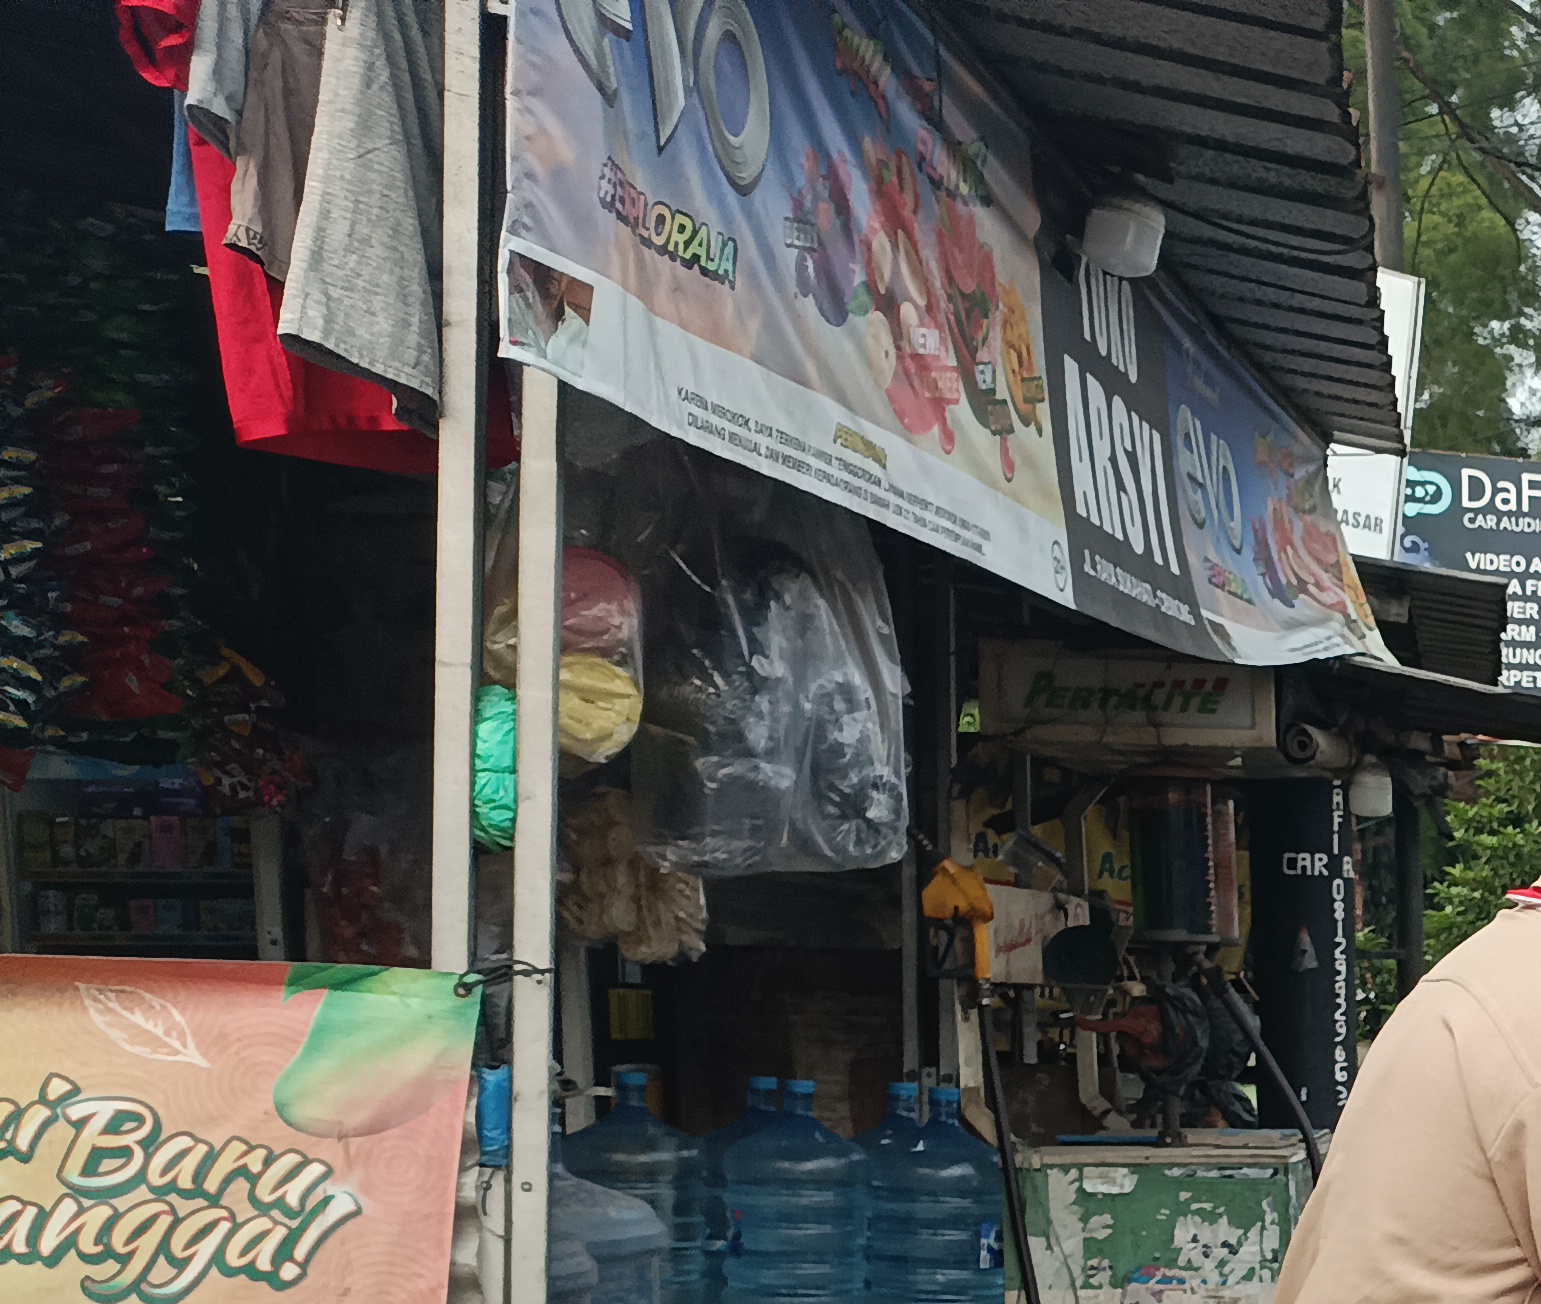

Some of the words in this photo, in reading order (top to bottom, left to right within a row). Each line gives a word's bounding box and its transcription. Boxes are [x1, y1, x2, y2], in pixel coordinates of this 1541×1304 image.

[1064, 353, 1181, 576] ARSYI
[1177, 403, 1243, 555] evo
[1462, 512, 1498, 530] CAR
[1465, 551, 1526, 573] VIDEO
[1282, 852, 1329, 877] CAR
[57, 1096, 334, 1220] Baru
